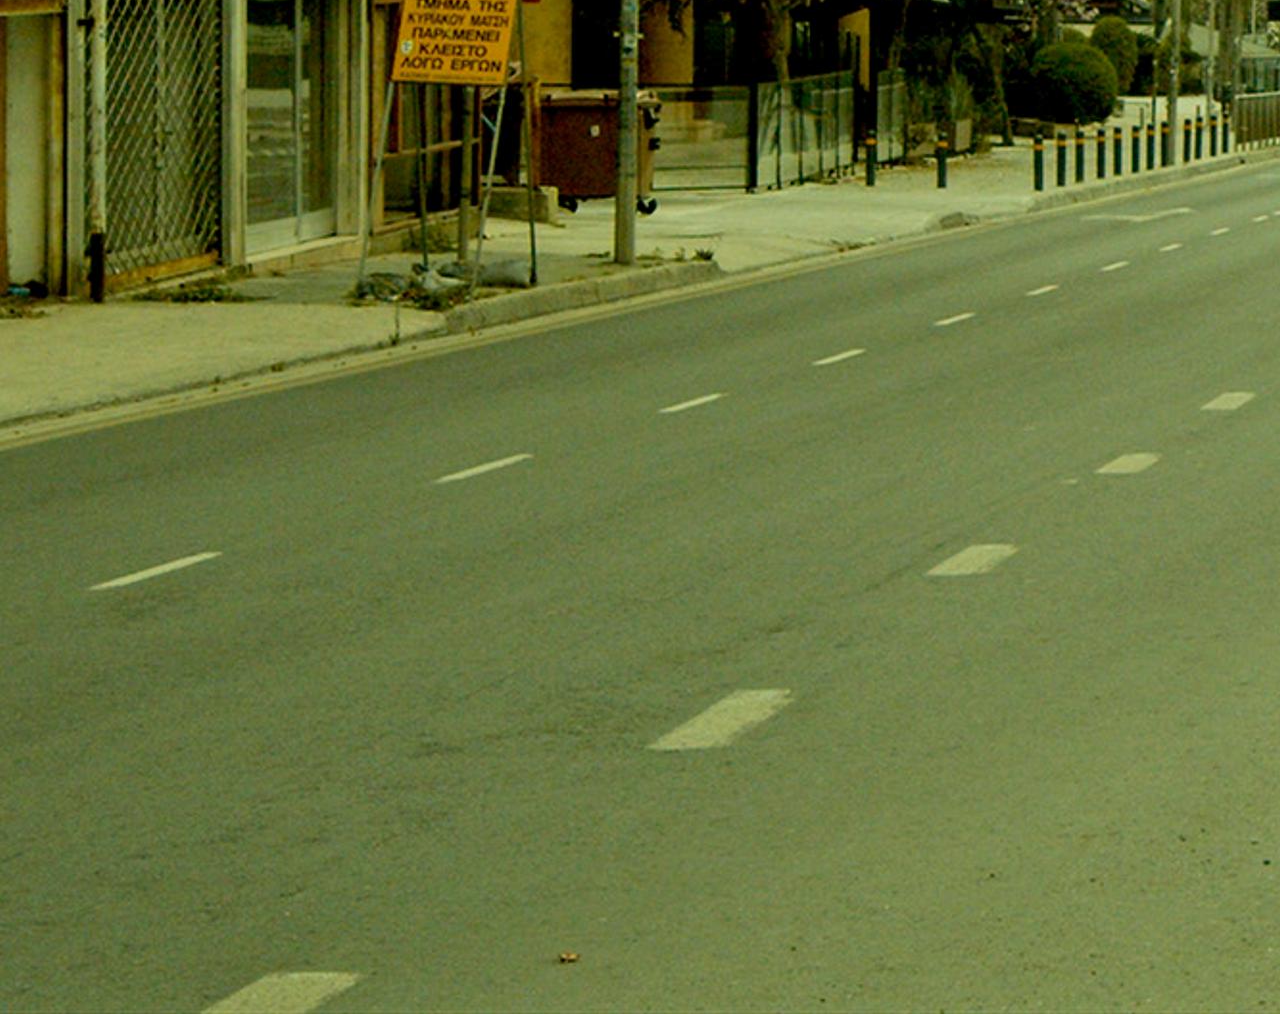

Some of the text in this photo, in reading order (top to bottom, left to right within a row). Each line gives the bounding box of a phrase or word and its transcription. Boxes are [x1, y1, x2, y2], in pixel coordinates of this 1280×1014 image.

[479, 0, 508, 13] ΤΗΣ
[407, 12, 509, 28] ΚΥΡΙΑΚΟΥ ΜΑΤΣΗ
[419, 43, 488, 58] ΚΛΕΙΣΤΟ
[400, 56, 502, 73] ΛΟΓΩ ΕΡΓΩΝ
